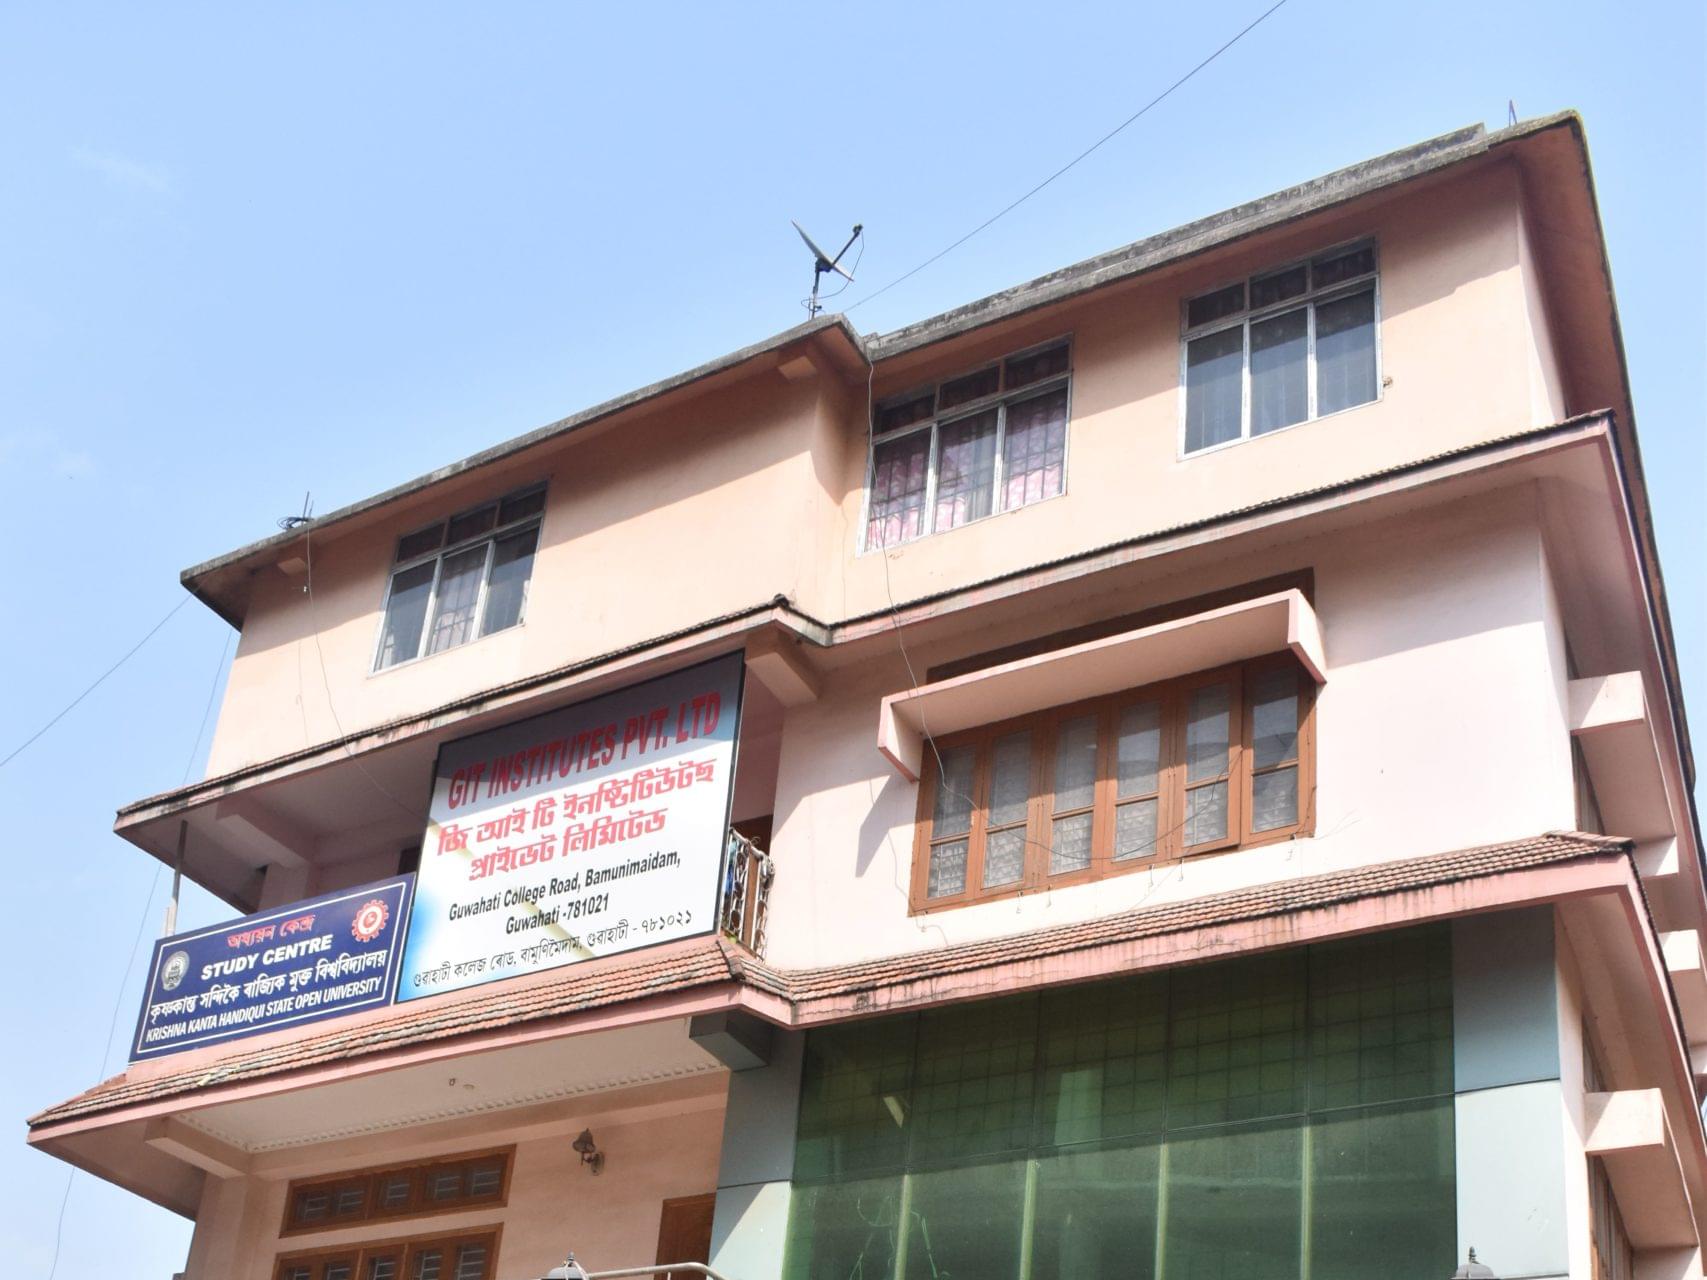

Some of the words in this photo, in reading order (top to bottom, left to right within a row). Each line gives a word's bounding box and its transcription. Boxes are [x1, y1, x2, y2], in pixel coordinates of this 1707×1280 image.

[448, 763, 486, 810] GIT
[487, 722, 618, 798] INSTITUTES
[675, 692, 721, 744] LTD
[437, 824, 473, 856] জি
[477, 808, 530, 843] আই
[532, 797, 557, 830] টি
[562, 808, 668, 857] লিমিটেড
[449, 892, 501, 921] Guwahati
[503, 884, 546, 907] College
[549, 872, 581, 897] Road,
[585, 851, 681, 887] Bamunimaidam,
[506, 905, 560, 935] Guwahati
[200, 953, 260, 980] STUDY
[262, 934, 334, 965] CENTRE
[289, 968, 313, 992] মুক্ত
[454, 957, 487, 977] কলেজ
[145, 1022, 186, 1042] KRISHNA
[187, 1014, 218, 1034] KANTA
[218, 1003, 266, 1027] HANDIQUI
[265, 996, 295, 1016] STATE
[294, 990, 322, 1010] OPEN
[323, 976, 382, 1003] UNIVERSITY
